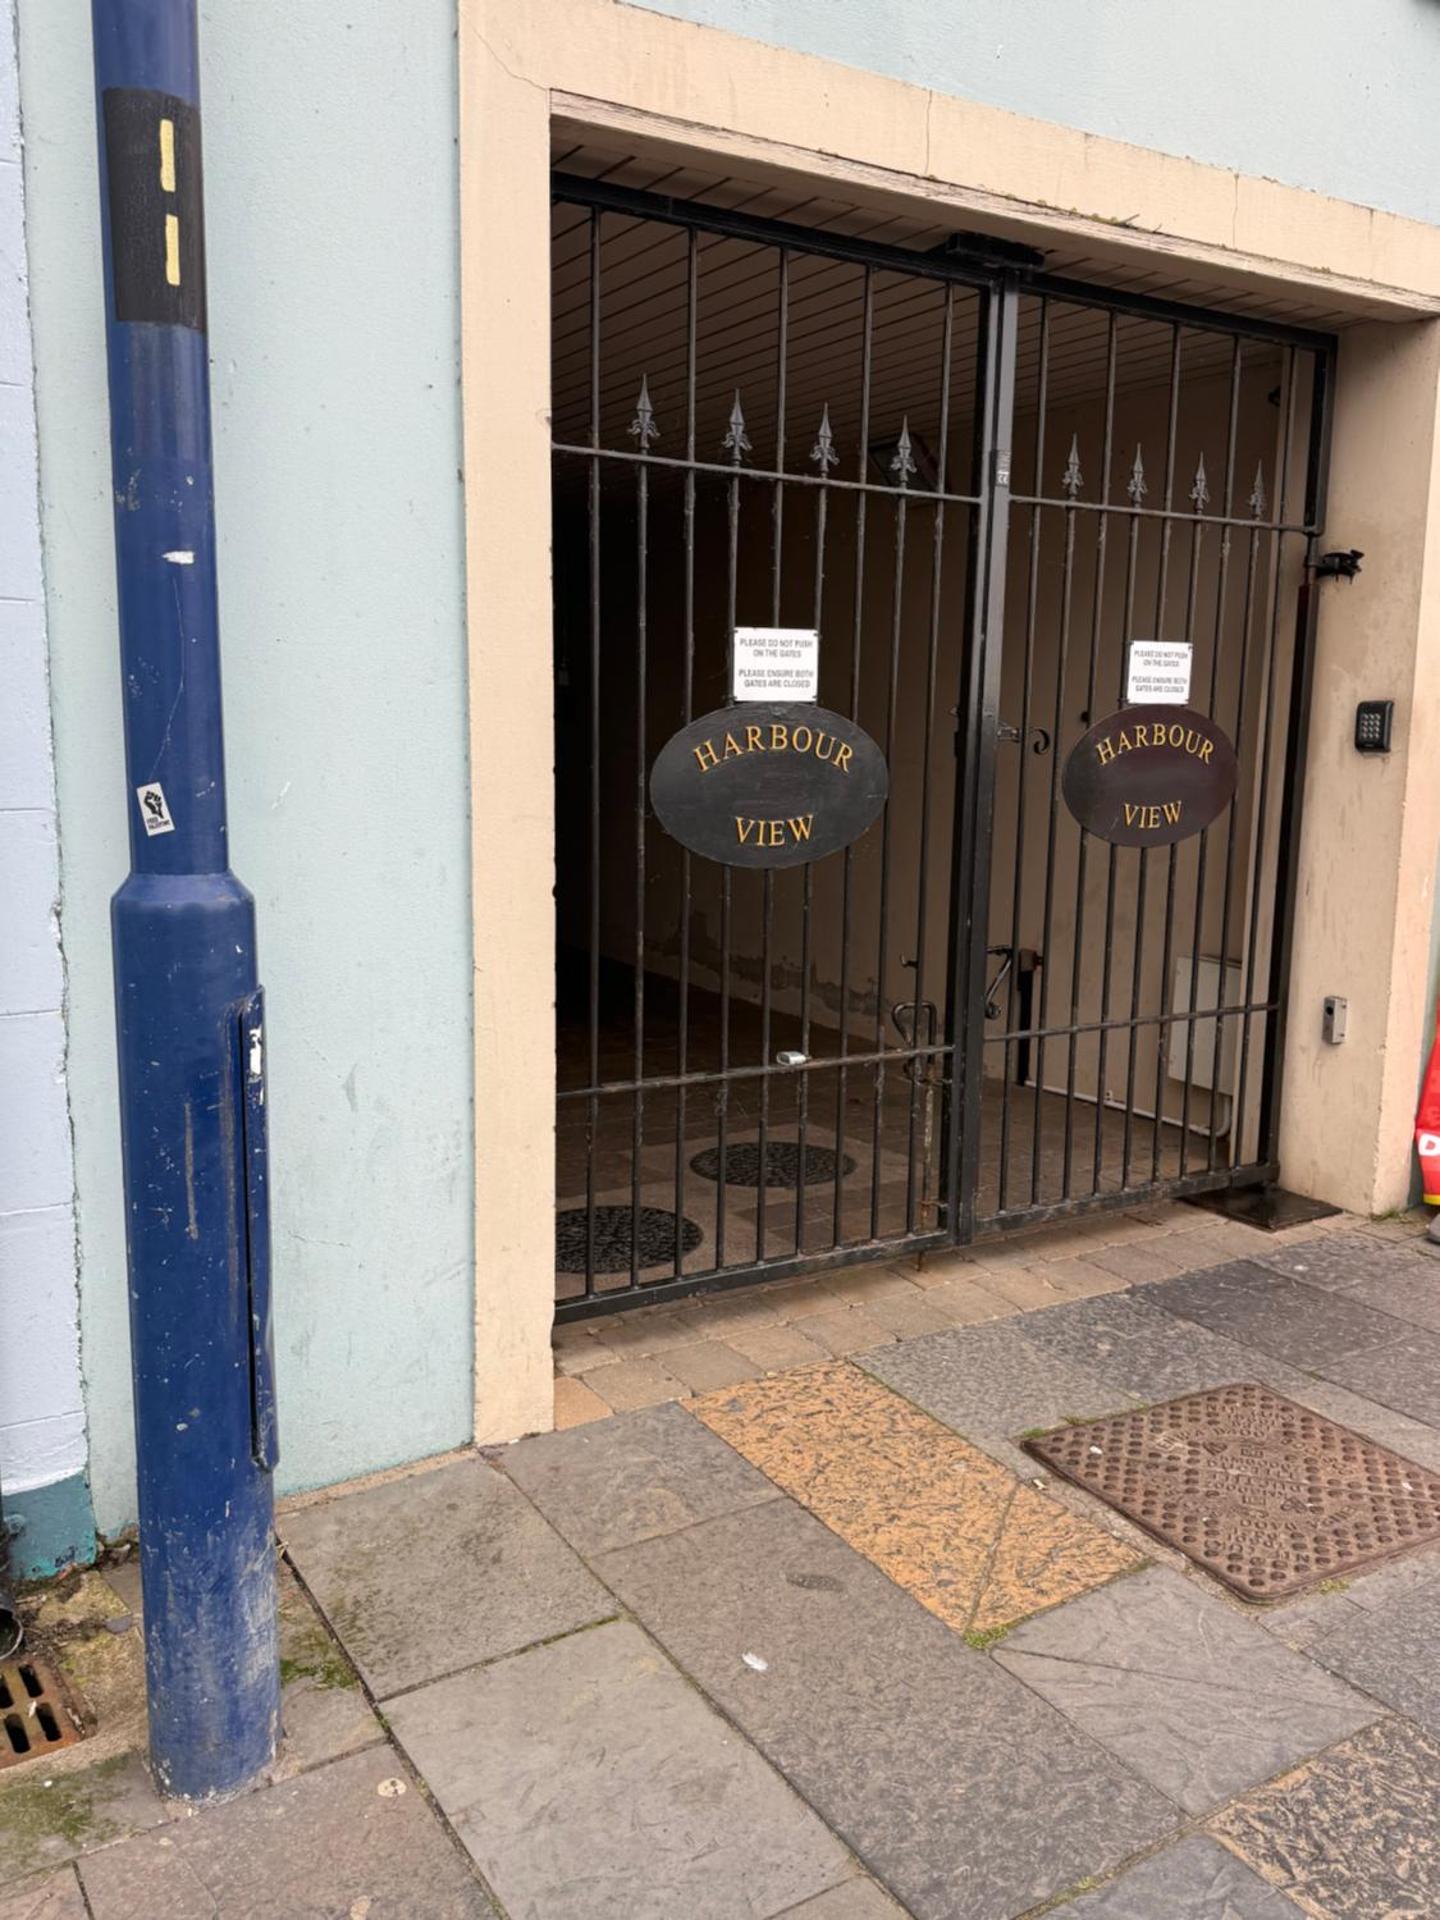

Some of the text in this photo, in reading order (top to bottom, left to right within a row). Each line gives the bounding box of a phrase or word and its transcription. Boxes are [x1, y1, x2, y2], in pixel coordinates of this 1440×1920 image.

[739, 638, 813, 648] PLEASE DO NOT PUSH
[753, 649, 802, 658] ON THE GATES
[738, 669, 814, 678] PLEASE ENSURE BOTH
[744, 679, 811, 688] GATES ARE CLOSED
[692, 723, 853, 773] HARBOUR
[1095, 723, 1214, 766] HARBOUR
[1123, 800, 1182, 829] VIEW
[735, 814, 814, 847] VIEW
